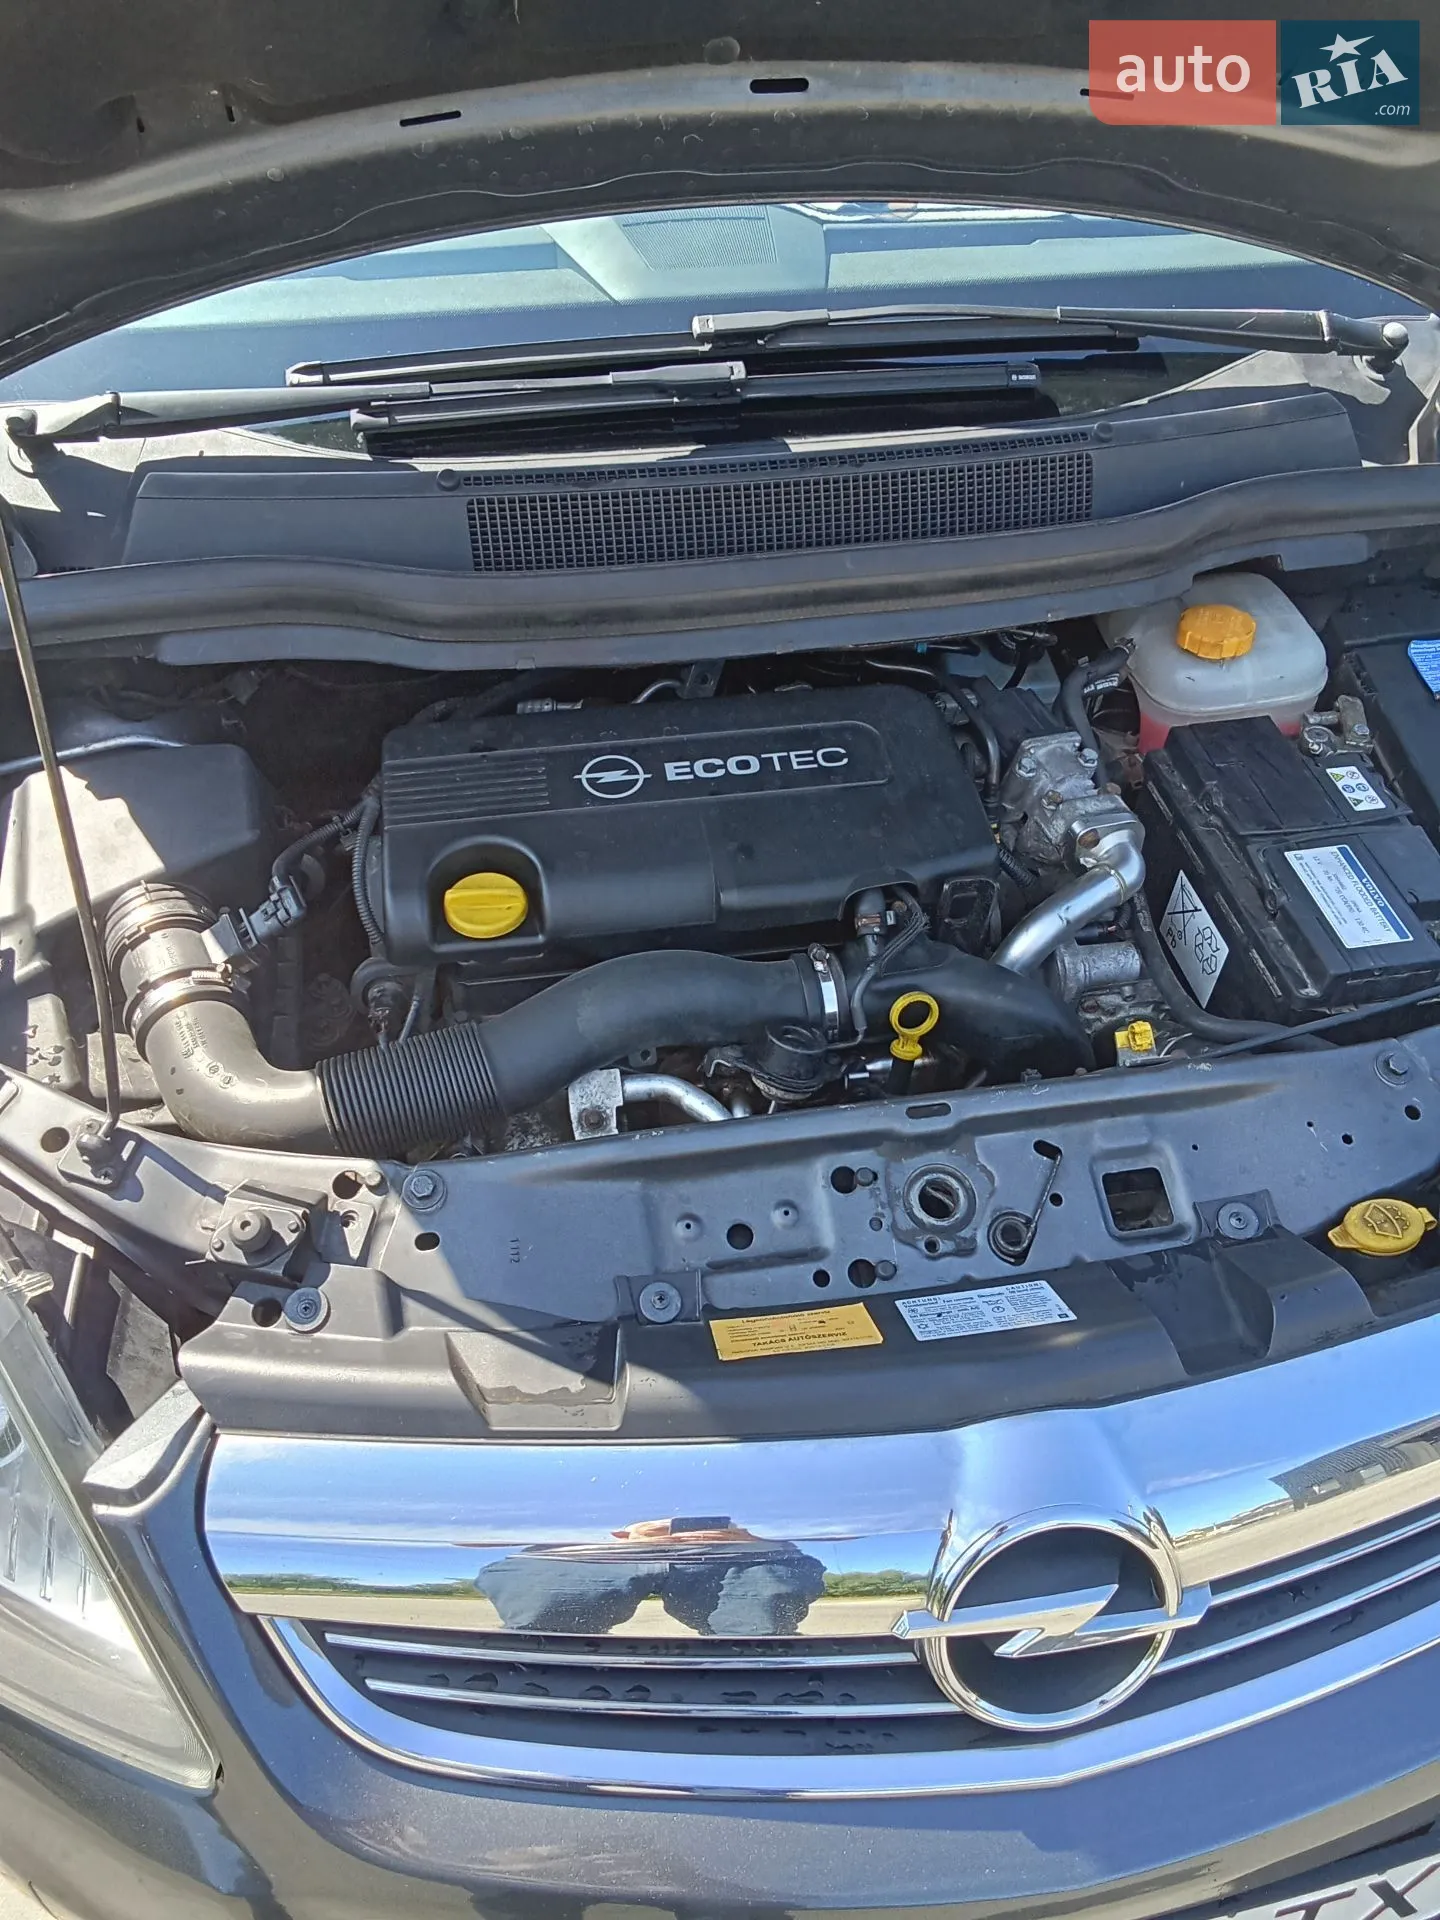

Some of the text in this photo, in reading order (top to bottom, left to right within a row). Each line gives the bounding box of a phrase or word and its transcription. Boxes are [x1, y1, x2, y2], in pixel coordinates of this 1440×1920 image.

[663, 747, 849, 782] ECOTEC
[1361, 878, 1386, 907] VOLVO
[1369, 906, 1392, 932] BATTERY
[1166, 927, 1177, 948] Pb
[752, 1337, 786, 1347] TAKÁCS
